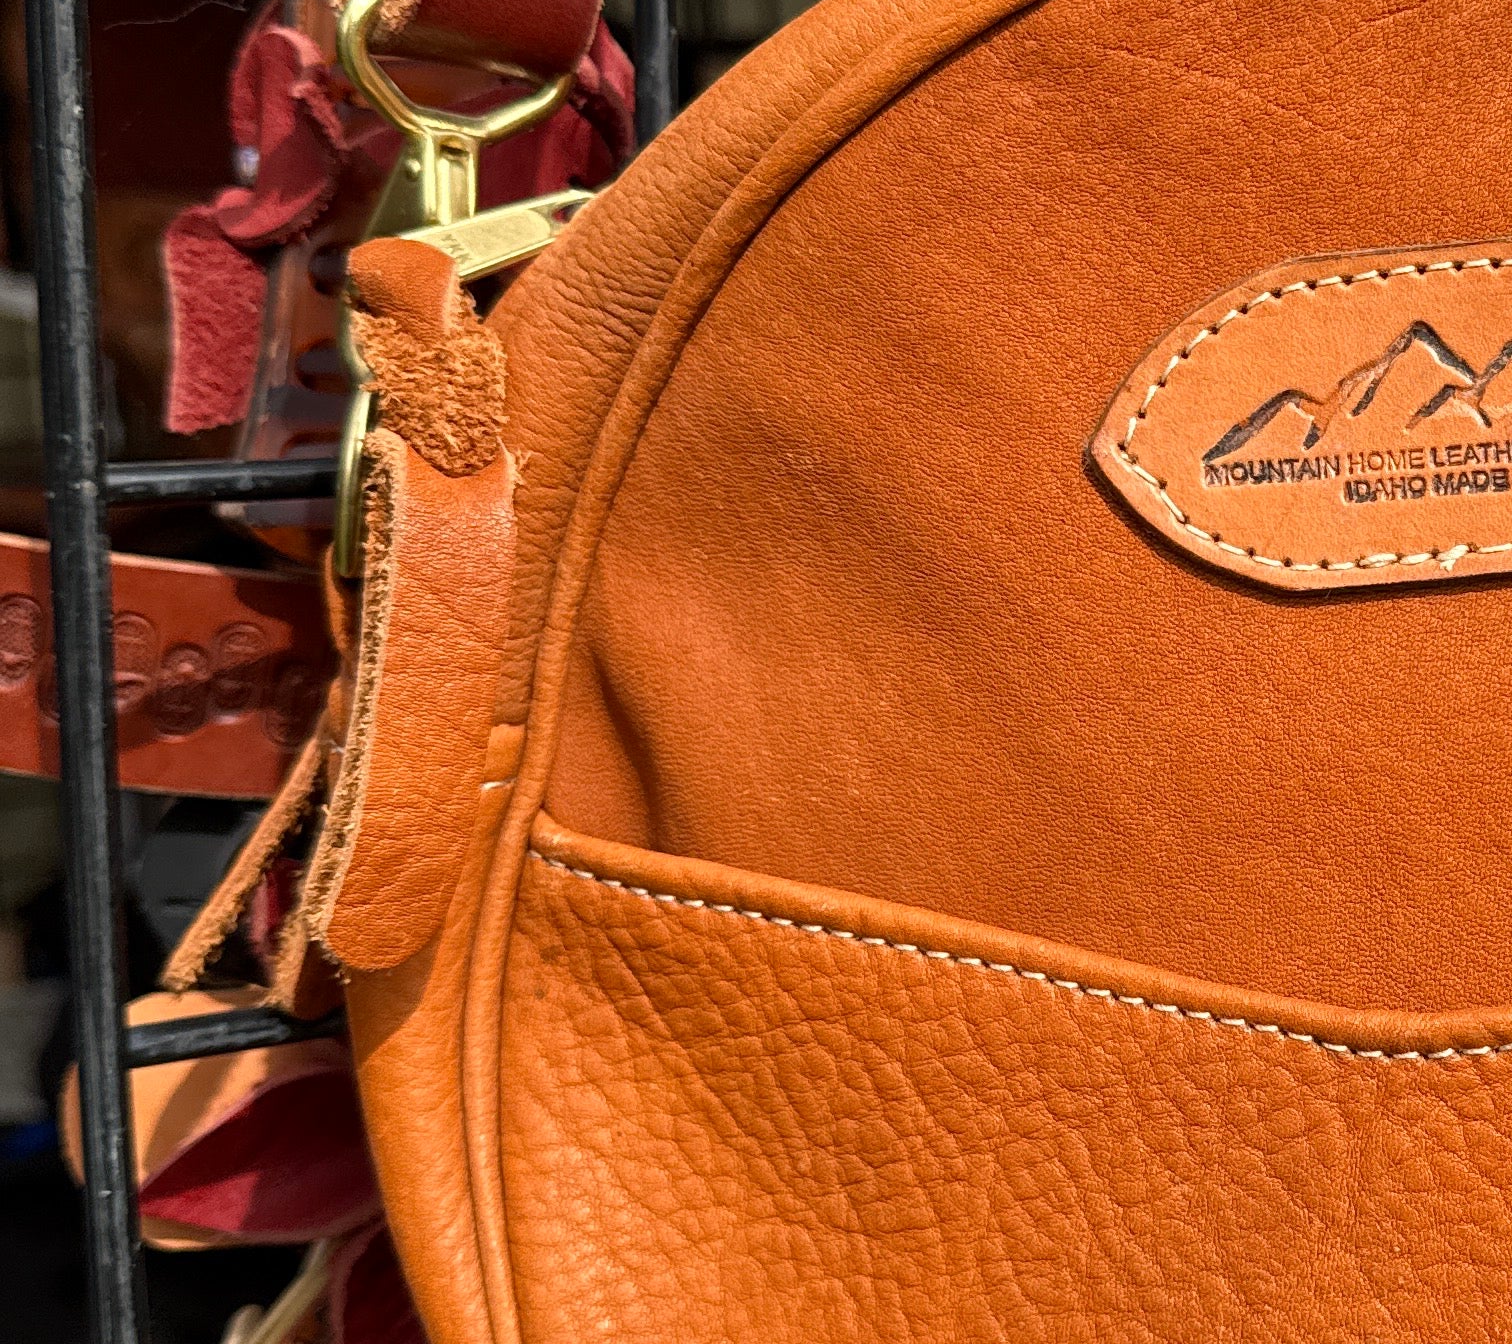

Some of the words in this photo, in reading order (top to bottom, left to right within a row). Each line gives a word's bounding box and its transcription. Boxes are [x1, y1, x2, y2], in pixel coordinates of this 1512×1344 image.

[440, 233, 473, 265] YKK
[1204, 455, 1341, 487] MOUNTAIN
[1346, 447, 1426, 475] HOME
[1342, 474, 1427, 503] IDAHO
[1431, 468, 1511, 496] MADE
